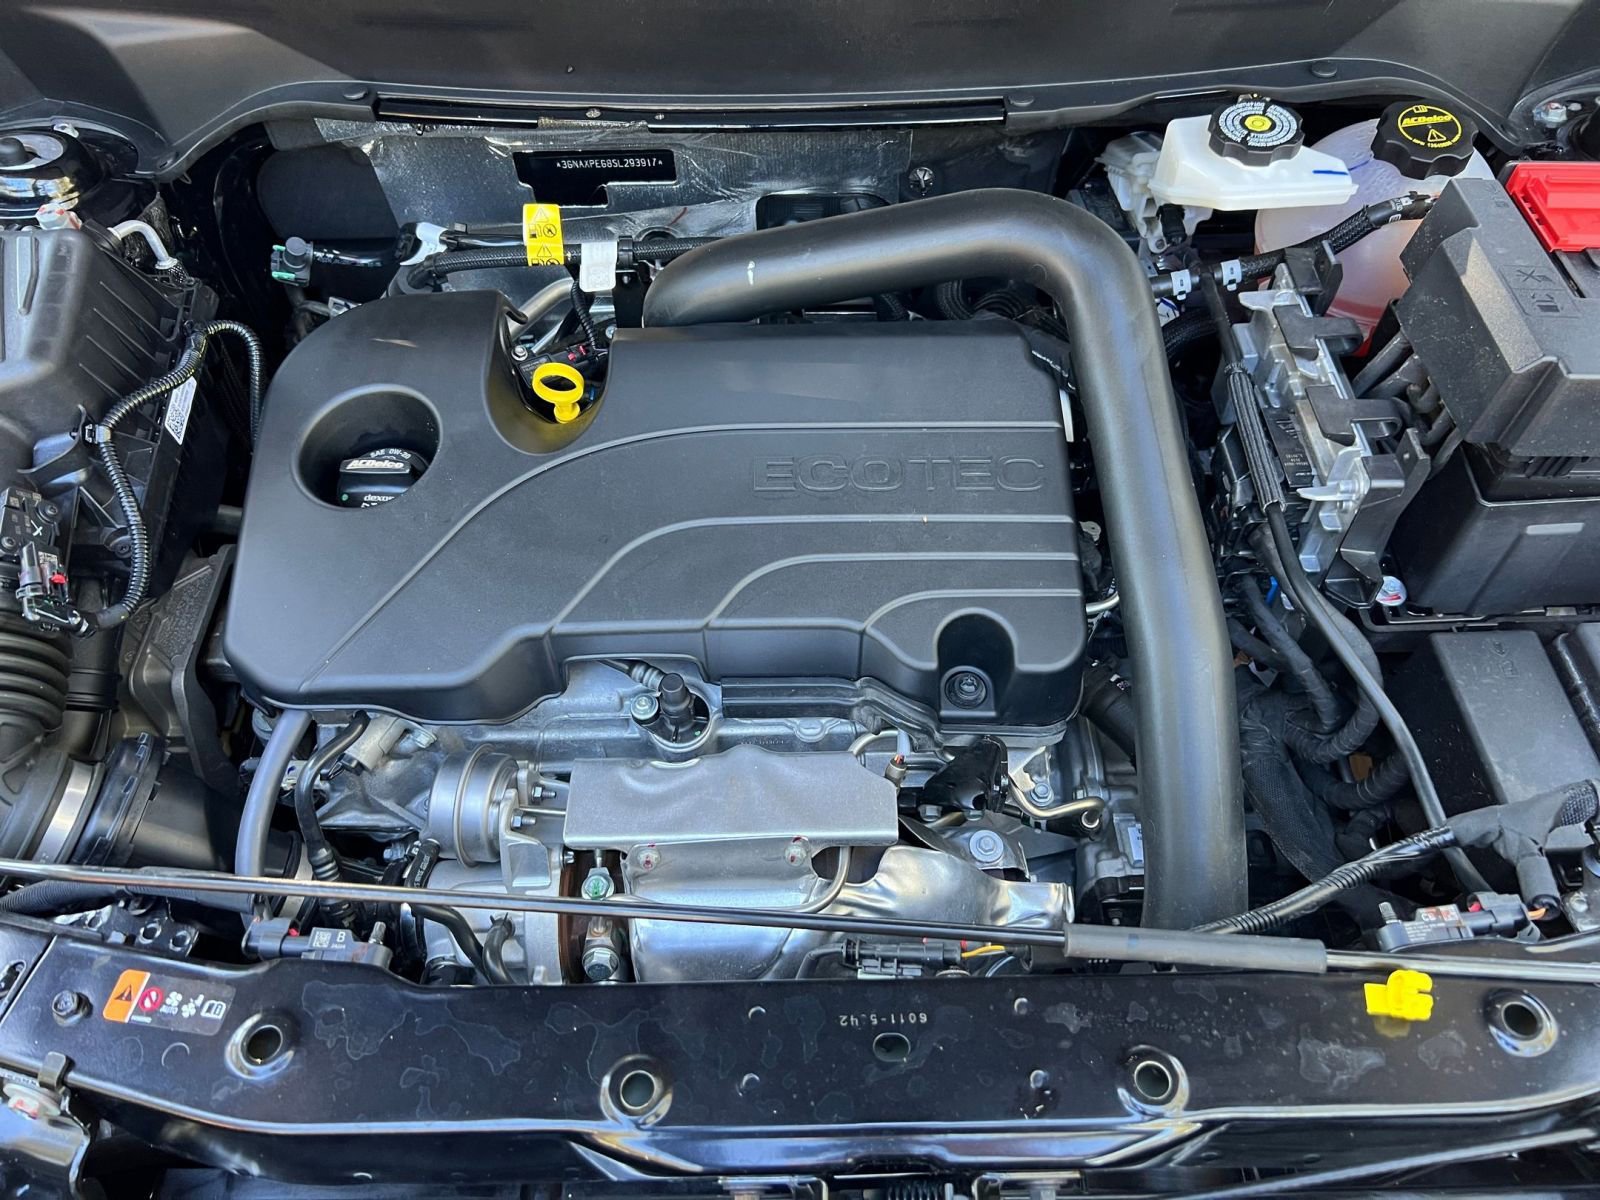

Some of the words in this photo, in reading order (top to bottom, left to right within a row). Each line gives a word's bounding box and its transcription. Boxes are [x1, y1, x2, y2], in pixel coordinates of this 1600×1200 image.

[1402, 115, 1453, 127] ACDelco
[370, 448, 386, 458] SAE
[346, 459, 405, 470] ACDelco
[753, 456, 1045, 492] ECOTEC
[159, 1004, 179, 1015] AUTO
